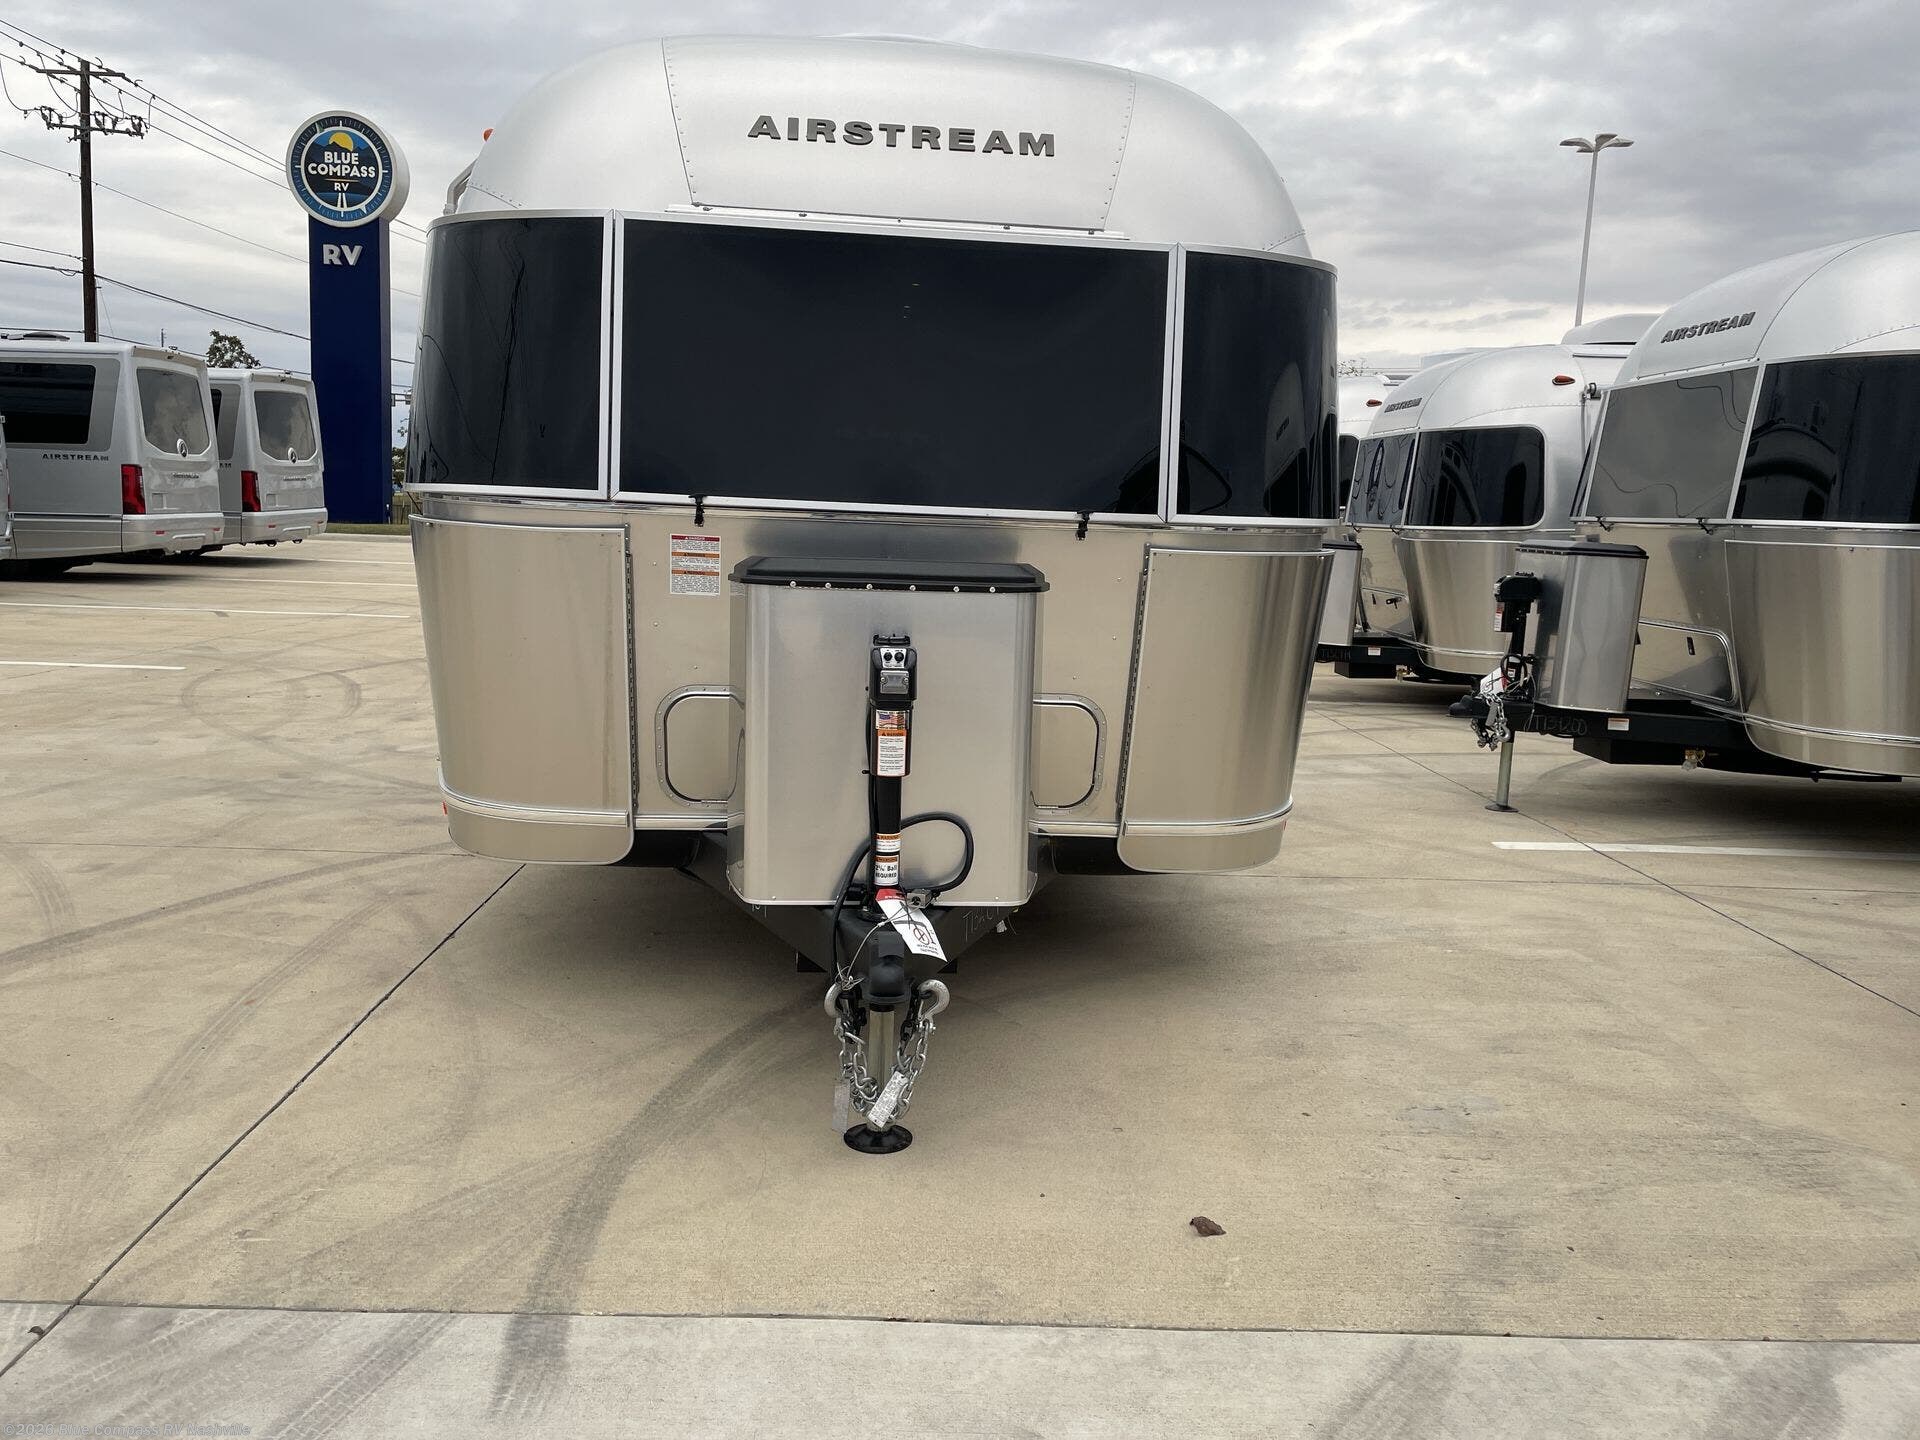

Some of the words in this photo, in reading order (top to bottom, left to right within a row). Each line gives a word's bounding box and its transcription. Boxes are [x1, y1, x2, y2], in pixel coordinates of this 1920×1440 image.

[748, 115, 1055, 157] AIRSTREAM
[324, 151, 359, 164] BLUE
[307, 163, 376, 178] COMPASS
[334, 182, 350, 192] RV
[322, 244, 363, 266] RV
[1660, 311, 1756, 344] AIRSTREAM
[42, 453, 109, 461] AIRSTREAM
